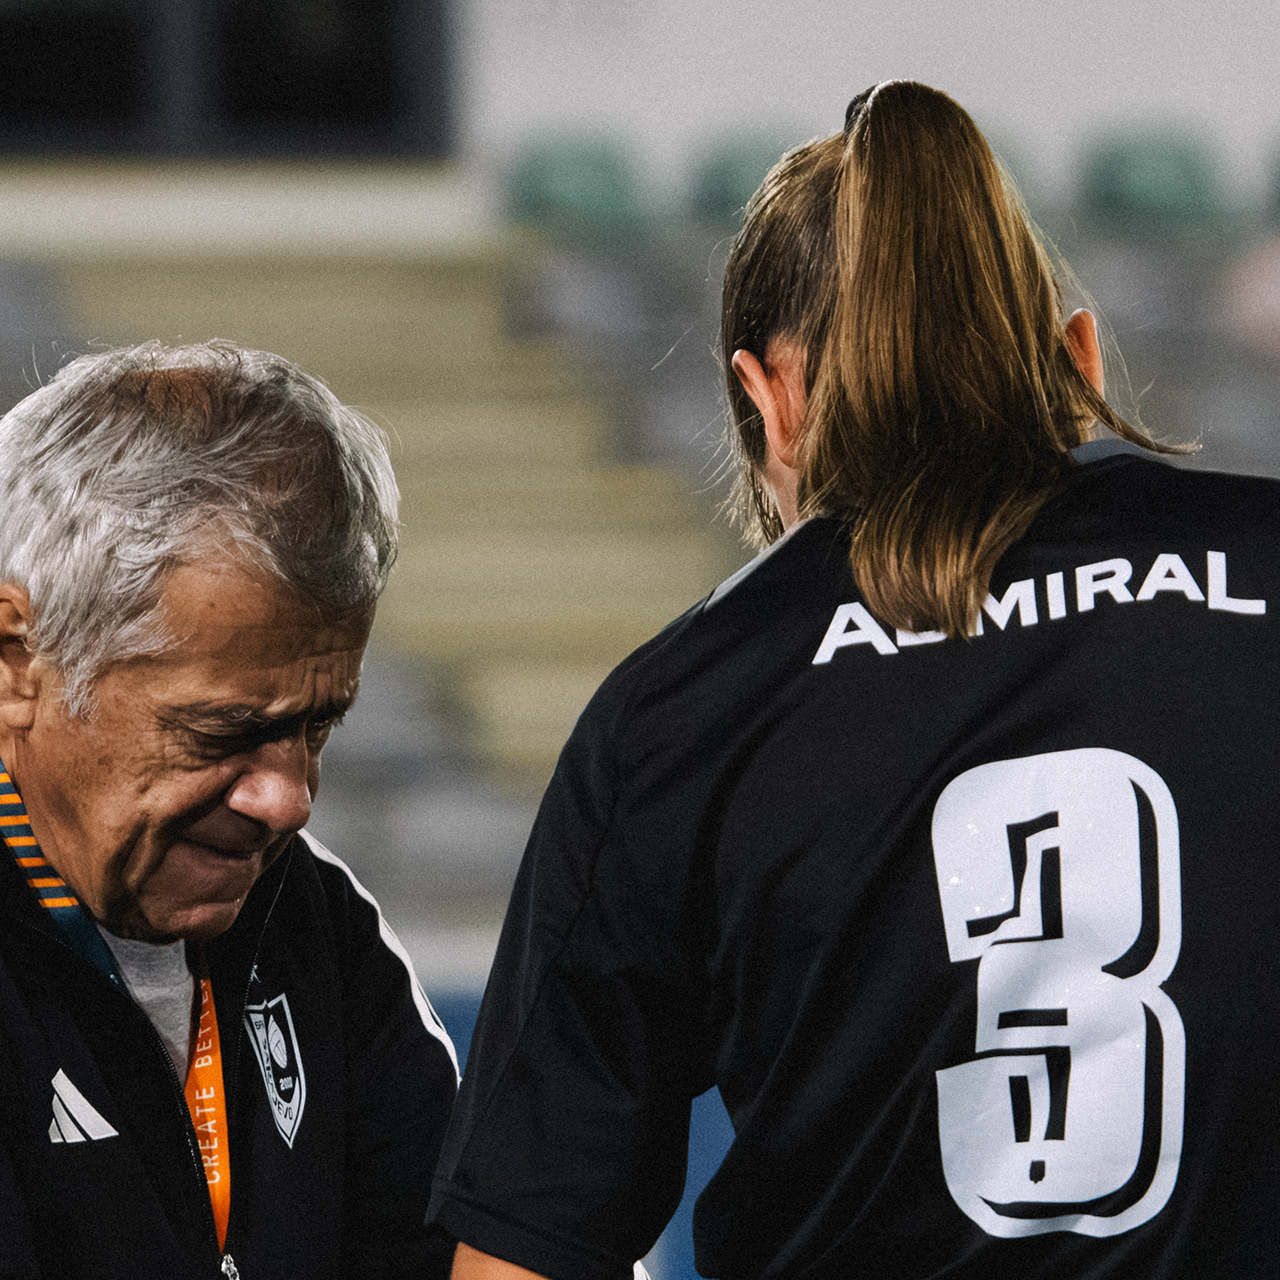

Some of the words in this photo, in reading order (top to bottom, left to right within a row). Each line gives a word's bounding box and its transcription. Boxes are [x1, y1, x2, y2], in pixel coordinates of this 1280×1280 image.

[812, 550, 1266, 665] AMIRAL
[931, 747, 1186, 1239] 3
[196, 1086, 220, 1184] CREATE
